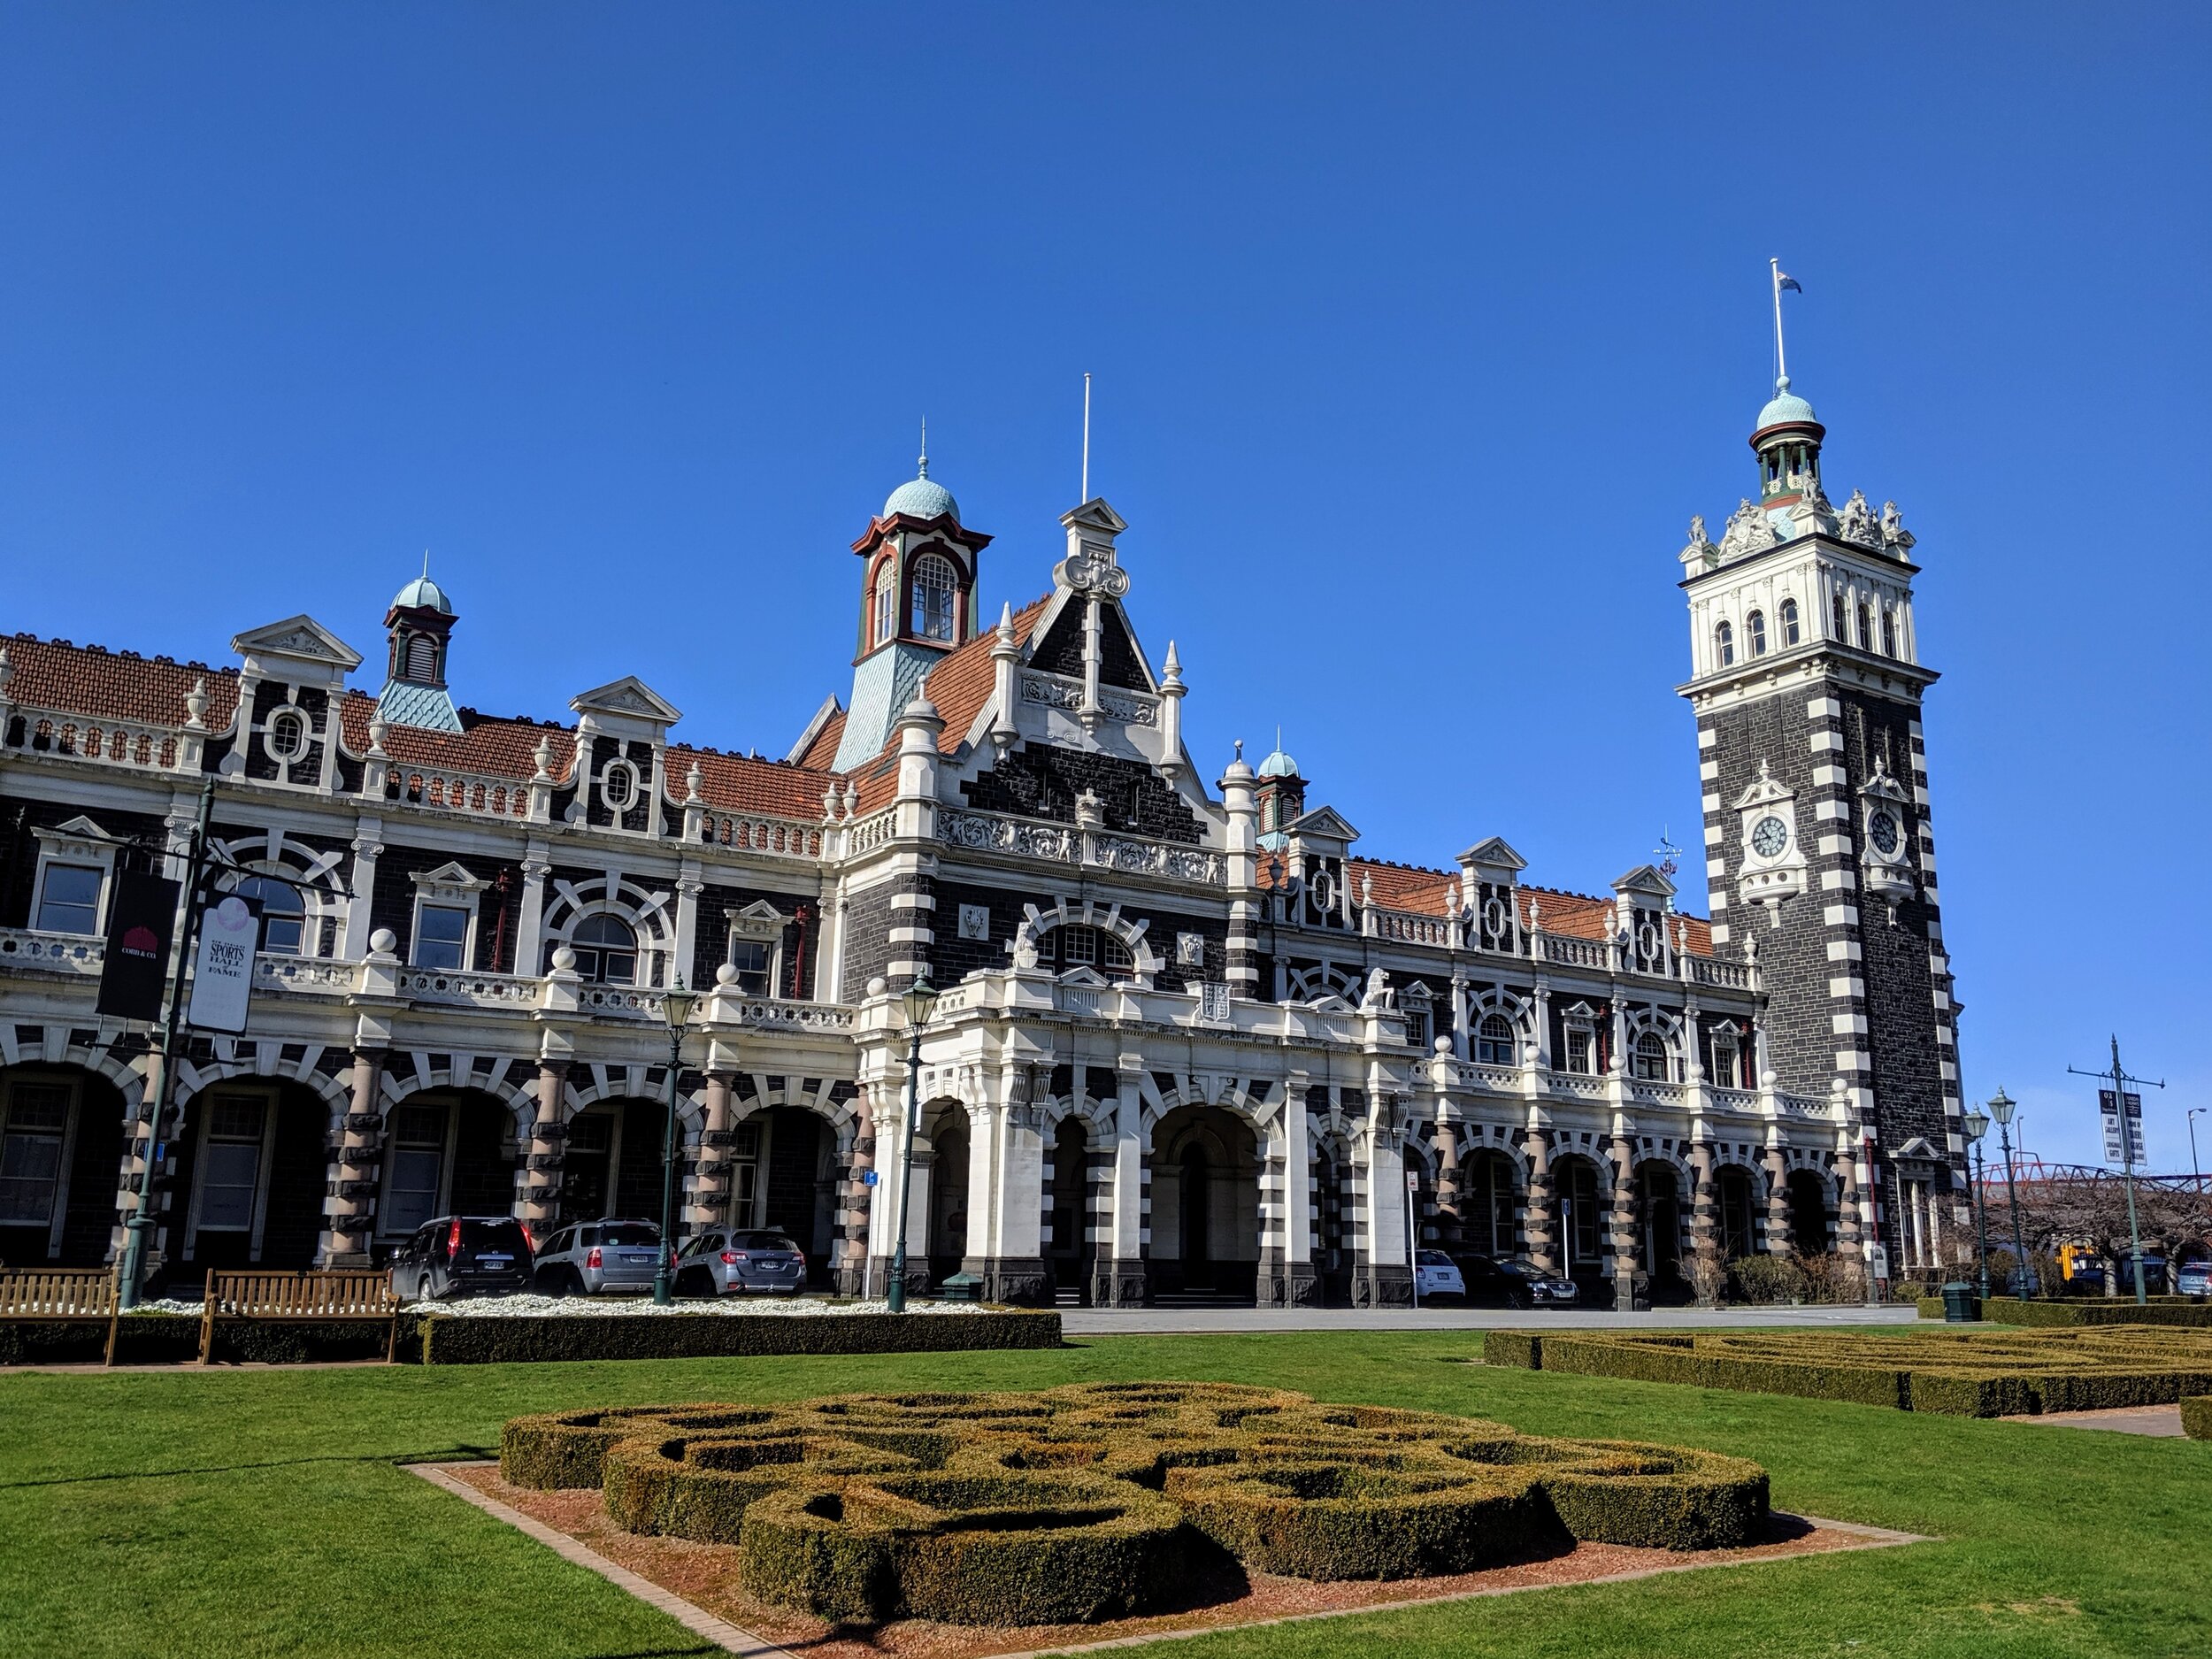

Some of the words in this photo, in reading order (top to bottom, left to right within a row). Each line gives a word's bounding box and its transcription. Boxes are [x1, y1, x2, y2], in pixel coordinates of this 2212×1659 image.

[210, 943, 245, 962] SPORTS
[210, 956, 242, 969] HALL
[208, 966, 242, 979] FAME
